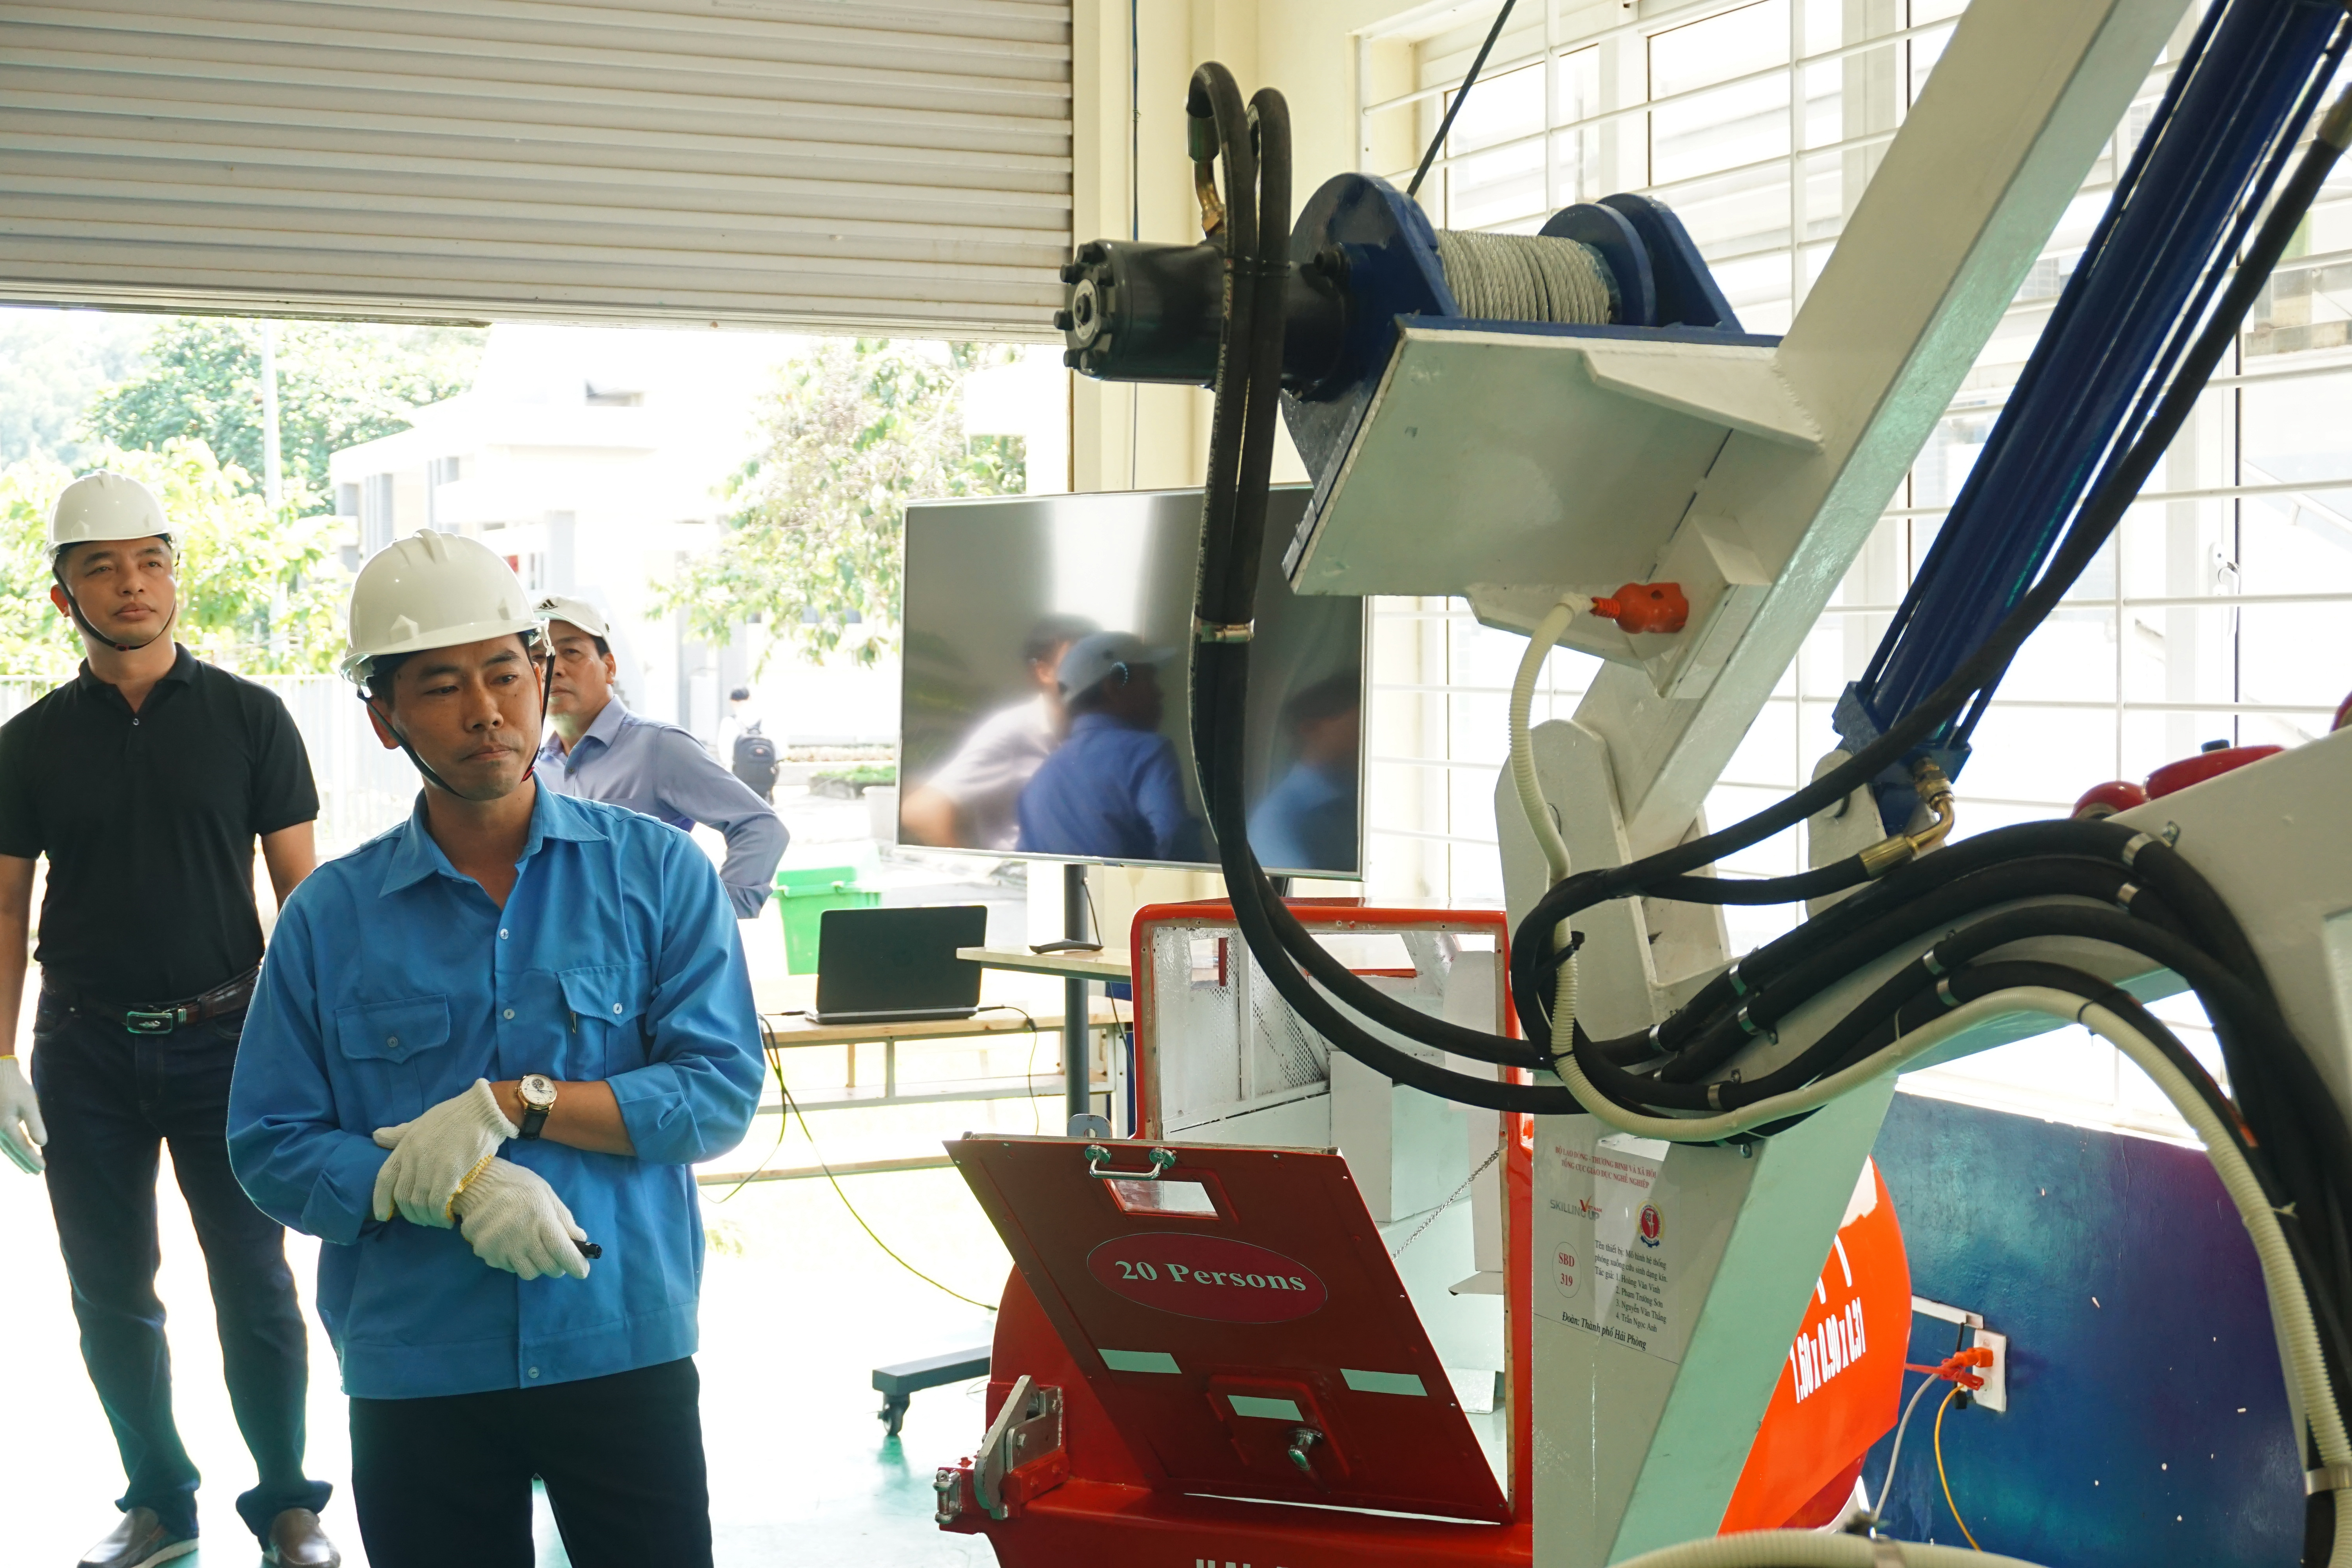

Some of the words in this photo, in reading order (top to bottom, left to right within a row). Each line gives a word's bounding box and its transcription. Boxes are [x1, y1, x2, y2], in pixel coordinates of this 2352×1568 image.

[1563, 1149, 1573, 1157] LAO
[1614, 1161, 1628, 1171] BINH
[1629, 1164, 1636, 1173] VÀ
[1646, 1169, 1656, 1180] HỘI
[1576, 1163, 1586, 1172] CỤC
[1601, 1170, 1612, 1180] DỤC
[1629, 1177, 1650, 1189] NGHIỆP
[1550, 1199, 1586, 1218] SKILLING
[1588, 1210, 1600, 1221] UP
[1559, 1252, 1575, 1267] SBD
[1595, 1240, 1604, 1250] Tên
[1606, 1243, 1616, 1254] thiết
[1626, 1249, 1634, 1258] Mô
[1635, 1252, 1645, 1262] hình
[1647, 1256, 1652, 1265] hệ
[1653, 1258, 1666, 1270] thống
[1115, 1261, 1158, 1281] 20
[1163, 1263, 1307, 1291] Persons
[1561, 1273, 1573, 1287] 319
[1595, 1254, 1609, 1267] phóng
[1635, 1266, 1645, 1275] sinh
[1647, 1269, 1658, 1281] dạng
[1659, 1273, 1668, 1282] kín.
[1595, 1266, 1604, 1276] Tác
[1606, 1270, 1614, 1279] giả:
[1622, 1275, 1637, 1288] Hoàng
[1638, 1280, 1647, 1290] Văn
[1616, 1286, 1620, 1294] 2.
[1622, 1288, 1634, 1299] Phạm
[1636, 1292, 1653, 1307] Trường
[1654, 1298, 1663, 1308] Sơn
[1616, 1299, 1620, 1307] 3.
[1622, 1300, 1639, 1313] Nguyễn
[1641, 1307, 1650, 1317] Văn
[1651, 1310, 1666, 1324] Thắng
[1616, 1312, 1620, 1320] 4.
[1621, 1313, 1632, 1324] Trần
[1633, 1318, 1646, 1329] Ngọc
[1647, 1323, 1657, 1332] Anh
[1562, 1311, 1580, 1326] Đoàn:
[1582, 1318, 1600, 1333] Thành
[1602, 1326, 1614, 1337] phố
[1614, 1329, 1625, 1342] Hải
[1627, 1333, 1646, 1351] Phòng
[1790, 1333, 1814, 1403] 1.60
[1817, 1314, 1842, 1383] 0.90
[1845, 1297, 1866, 1362] 0.31
